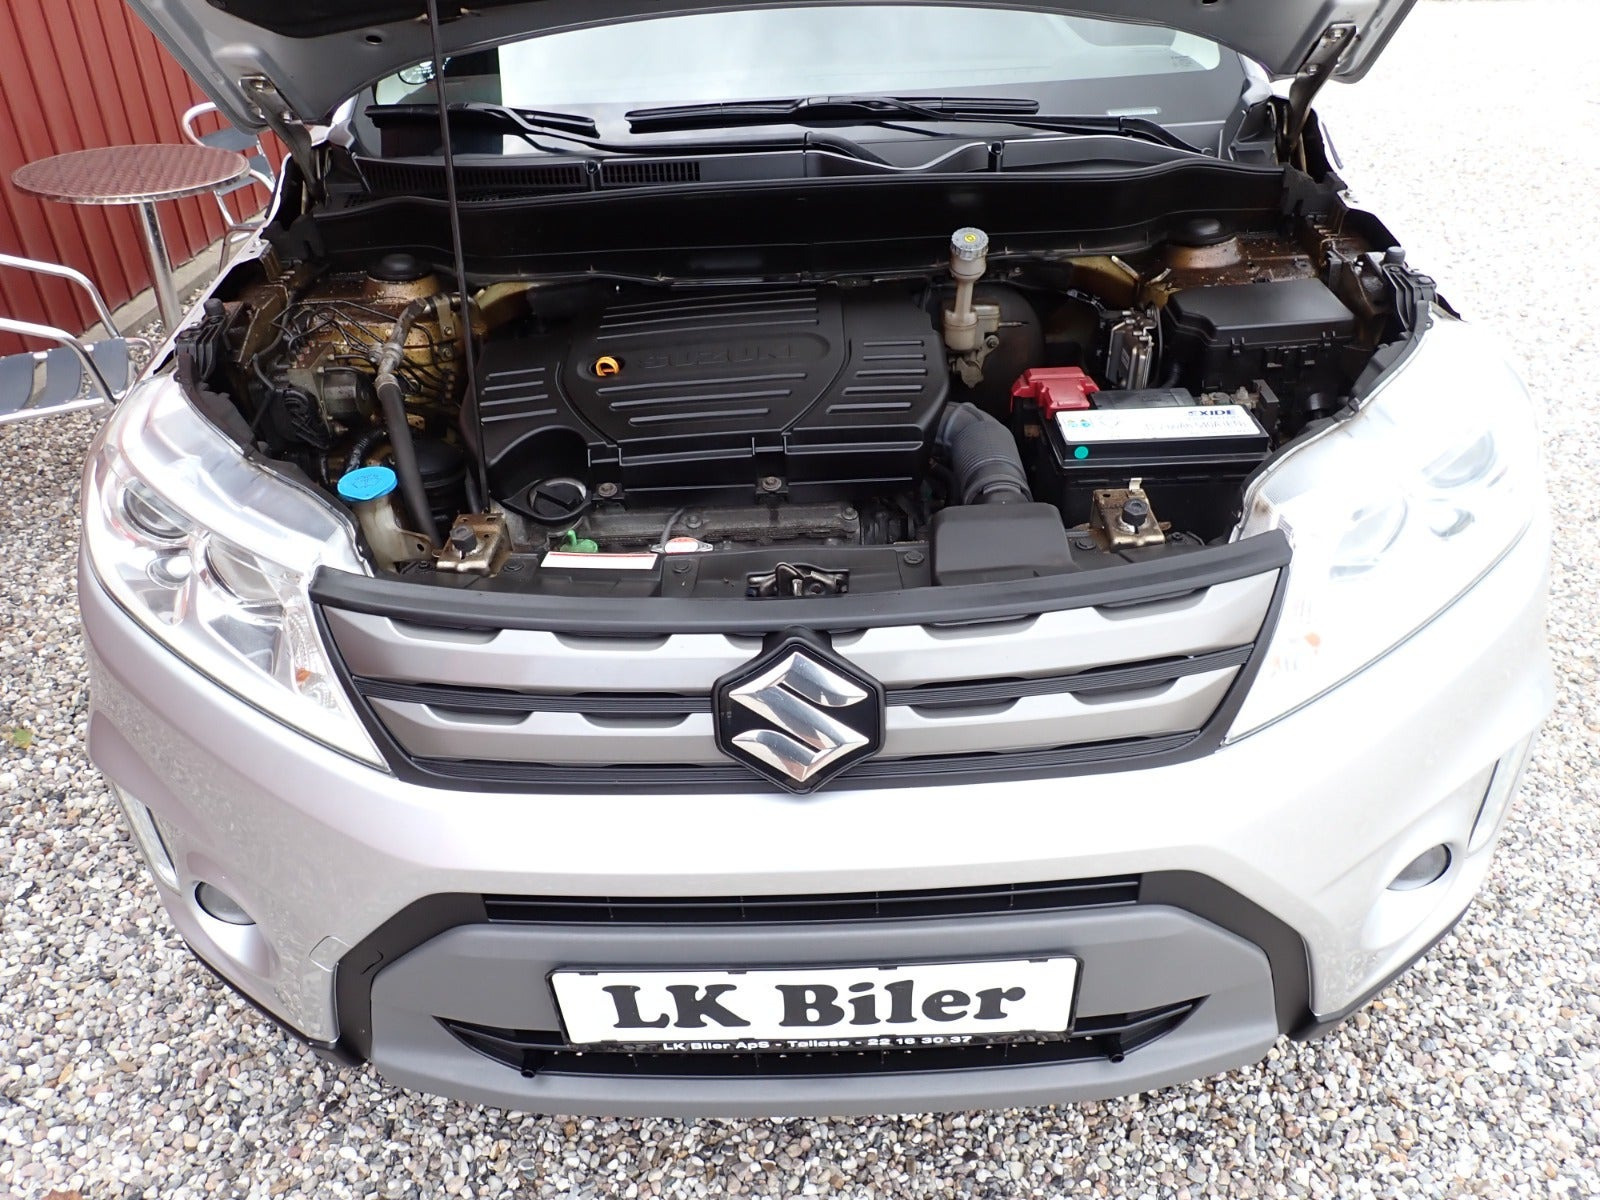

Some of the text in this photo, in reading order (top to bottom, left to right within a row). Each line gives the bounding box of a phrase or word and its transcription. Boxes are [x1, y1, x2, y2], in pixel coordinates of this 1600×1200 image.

[602, 980, 1026, 1029] LK Biler
[663, 1042, 686, 1050] LK
[735, 1041, 770, 1051] ApS
[921, 1036, 944, 1044] 30
[950, 1035, 972, 1043] 37
